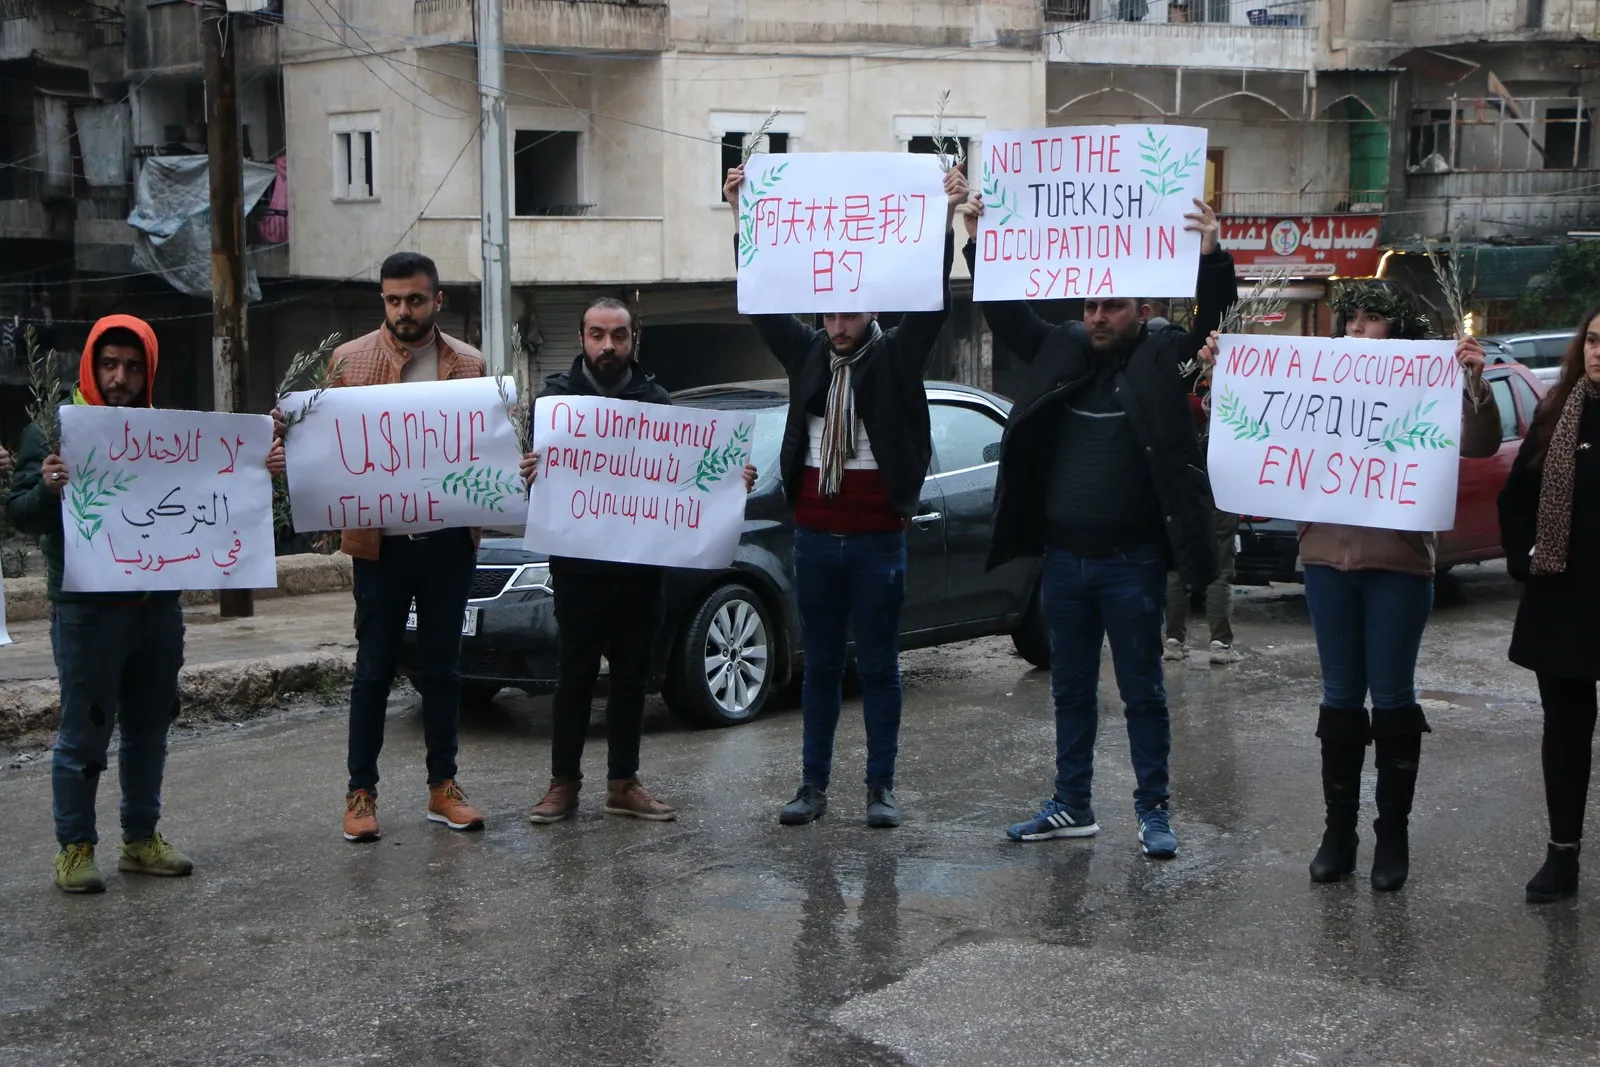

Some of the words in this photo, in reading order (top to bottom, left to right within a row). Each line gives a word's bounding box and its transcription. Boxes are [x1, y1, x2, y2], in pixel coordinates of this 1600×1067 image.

[992, 142, 1022, 174] NO
[1031, 138, 1062, 173] TO
[1071, 135, 1121, 173] THE
[1028, 182, 1143, 219] TURKISH
[983, 224, 1132, 262] OCCUPATION
[1146, 225, 1175, 260] IN
[1301, 217, 1378, 259] صيدلية
[1025, 267, 1114, 298] SYRIA
[1225, 345, 1280, 377] NON
[1258, 390, 1388, 443] TURQUE
[109, 420, 202, 463] للاحتلال
[218, 433, 245, 474] لا
[1258, 445, 1315, 490] EN
[1320, 452, 1419, 505] SYRIE
[121, 486, 230, 538] التركي
[107, 533, 201, 575] سوريا
[211, 530, 242, 575] في
